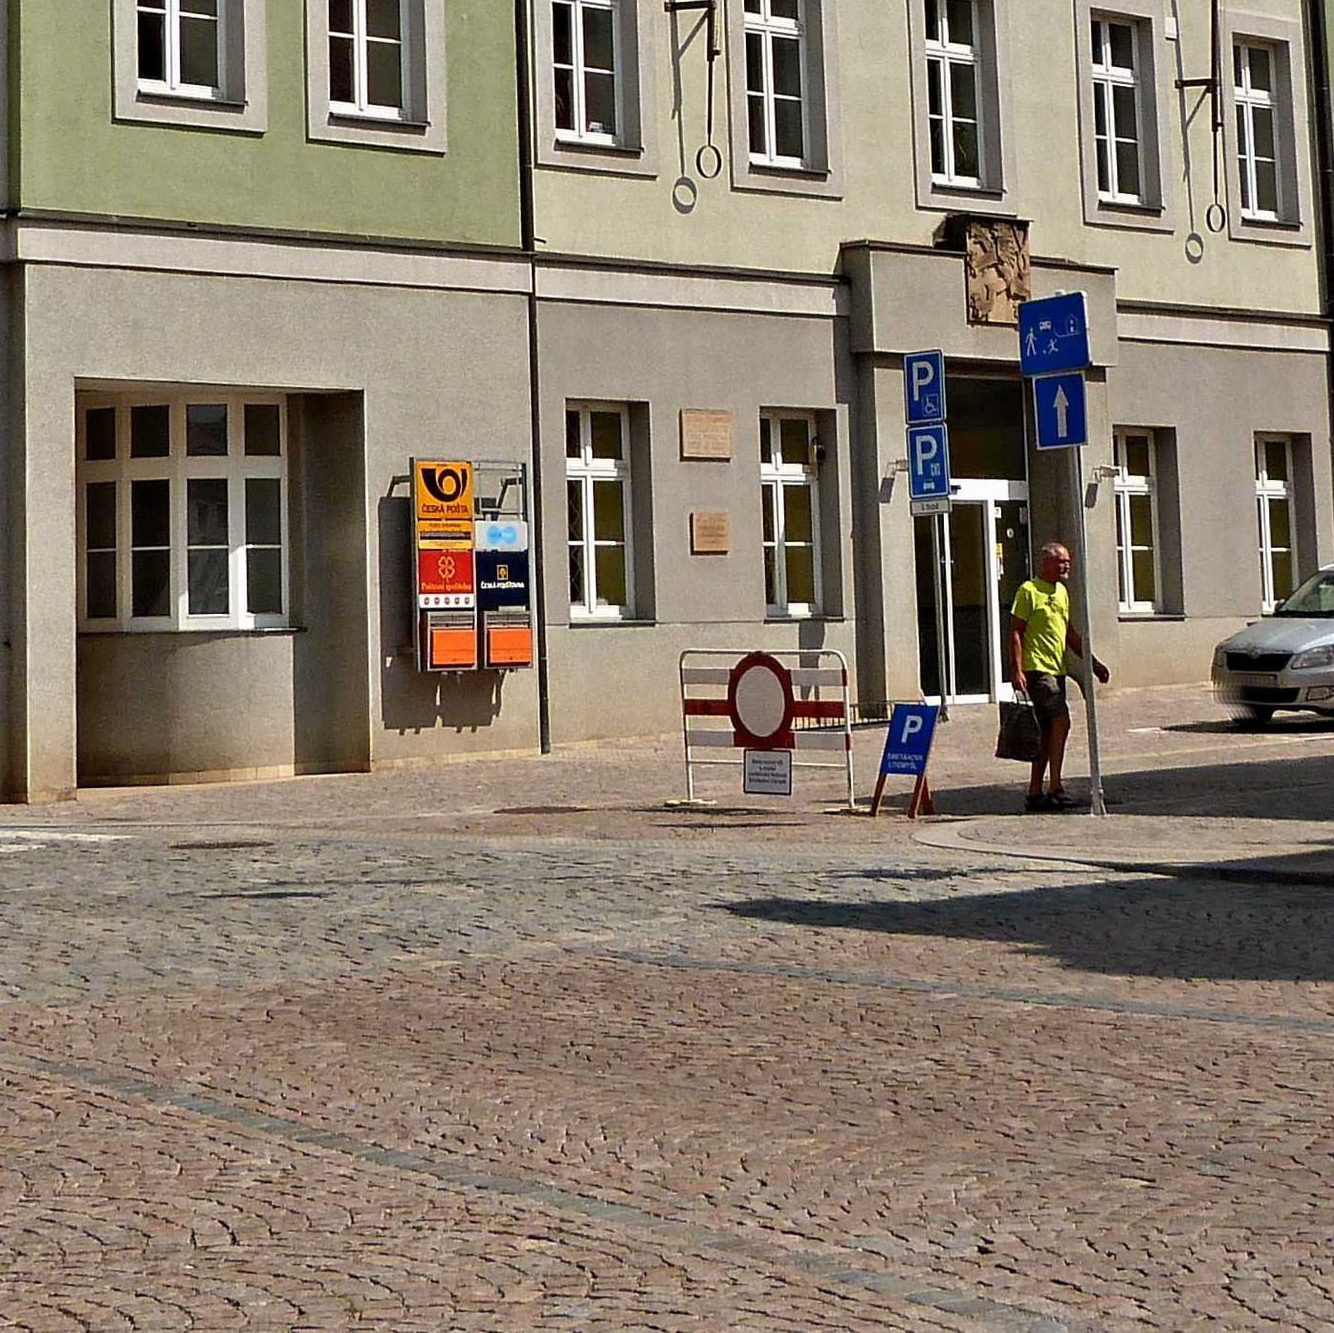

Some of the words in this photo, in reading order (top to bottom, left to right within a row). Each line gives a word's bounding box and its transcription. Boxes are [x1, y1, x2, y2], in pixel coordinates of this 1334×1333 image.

[912, 361, 935, 401] P
[915, 435, 938, 476] P
[421, 503, 445, 514] ČESKÁ
[446, 503, 469, 514] POŠTA
[901, 714, 923, 743] P
